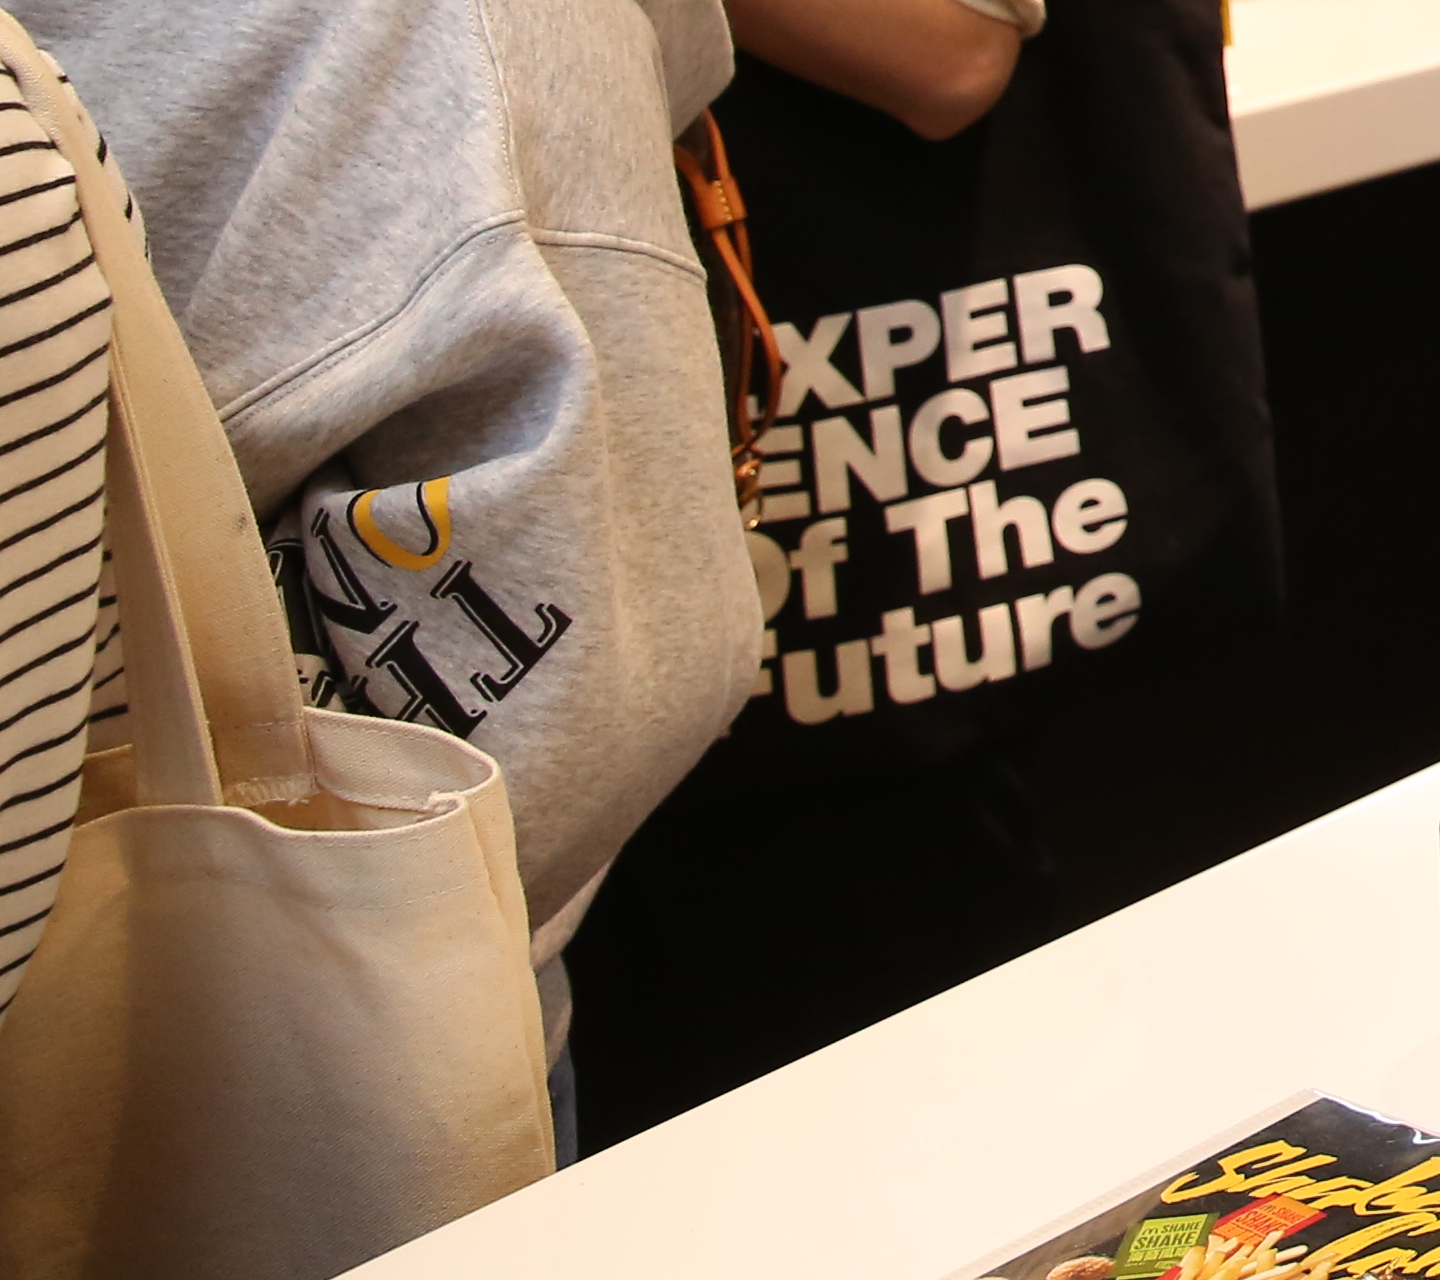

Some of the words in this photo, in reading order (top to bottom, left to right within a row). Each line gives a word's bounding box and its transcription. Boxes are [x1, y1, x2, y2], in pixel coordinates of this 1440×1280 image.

[749, 263, 1111, 420] XPER
[884, 477, 1129, 596] The
[1134, 1231, 1196, 1250] SHAKE
[1161, 1220, 1202, 1233] SHAKE
